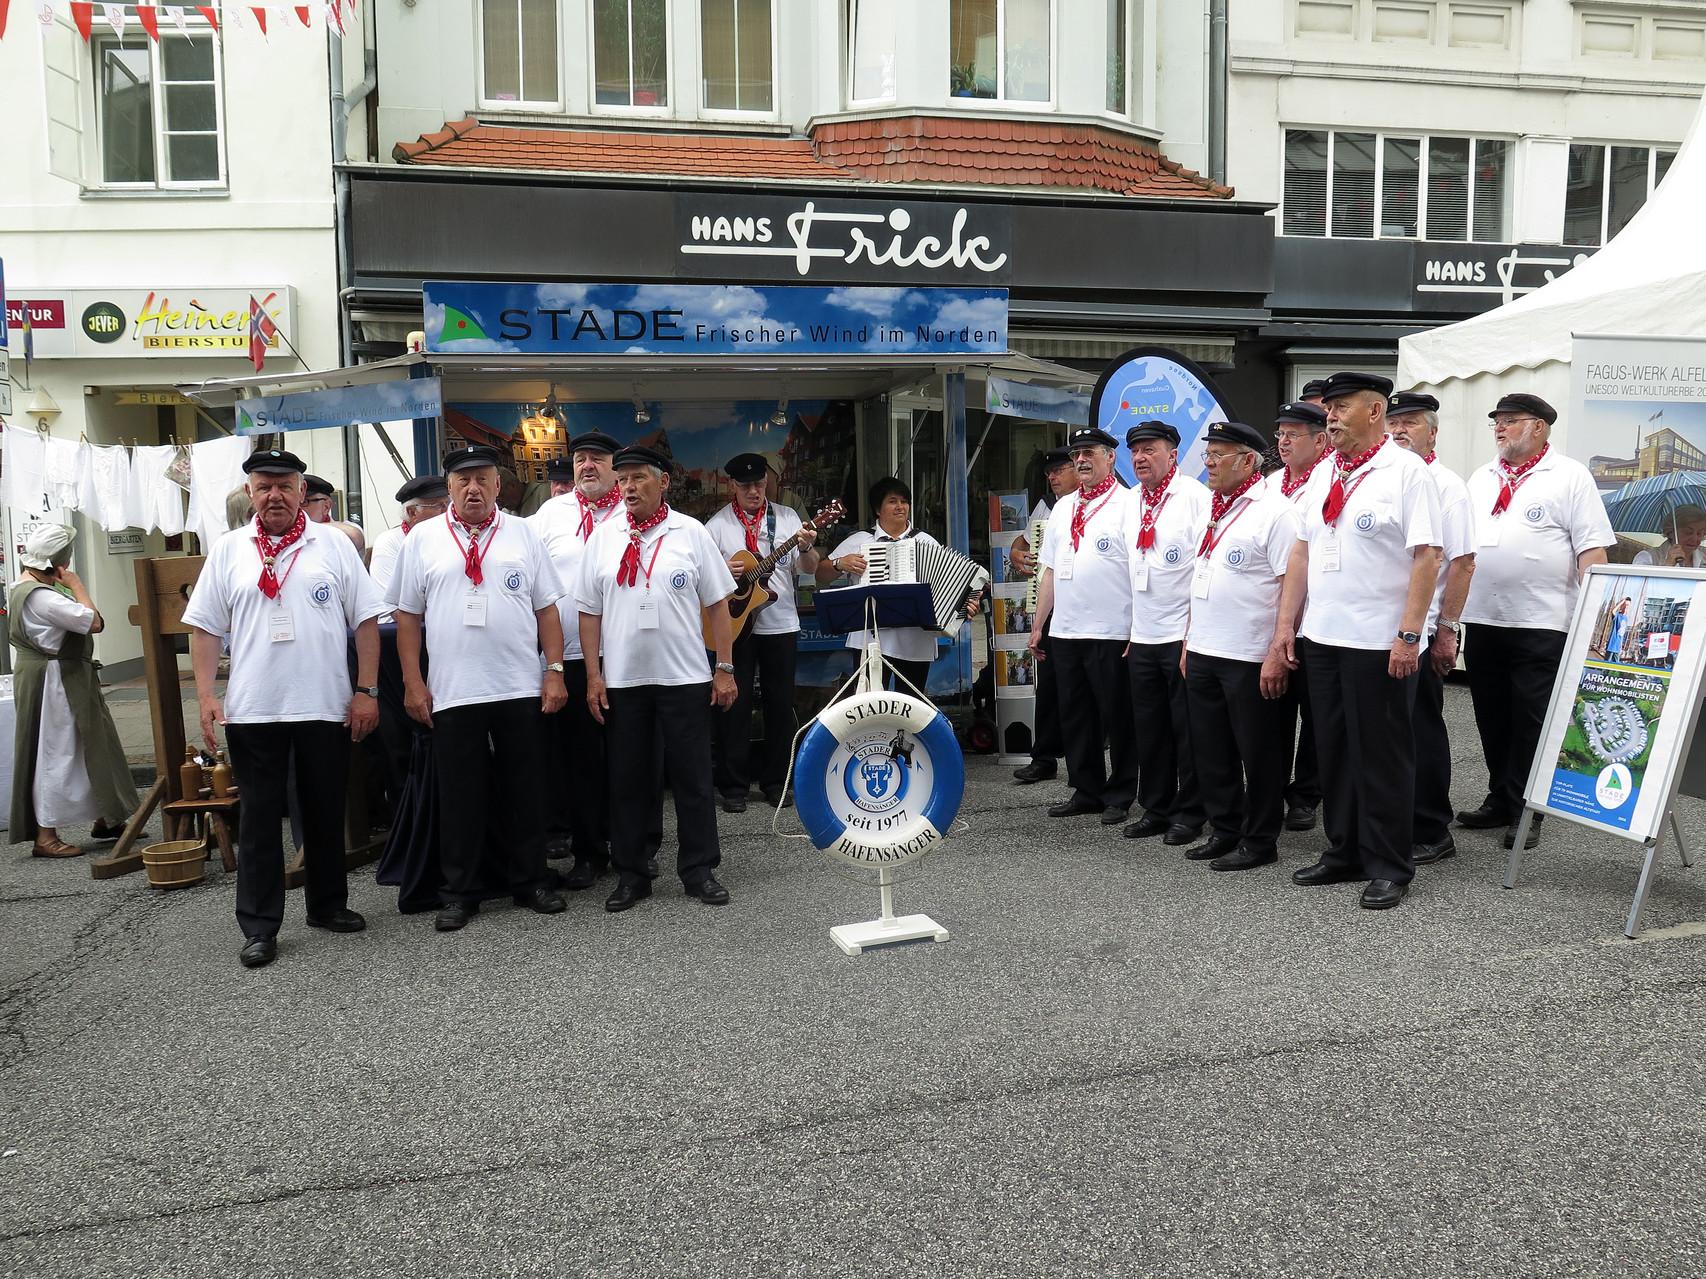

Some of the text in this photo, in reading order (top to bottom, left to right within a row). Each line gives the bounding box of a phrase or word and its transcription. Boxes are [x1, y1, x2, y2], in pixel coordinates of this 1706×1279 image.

[691, 201, 1007, 275] HANS Frick
[1425, 260, 1486, 282] HANS
[88, 315, 119, 332] JEVER
[499, 308, 998, 343] STADE Frischer Wind im Norden
[1587, 364, 1668, 381] FAGUS-WERK
[1585, 384, 1619, 395] UNESCO
[1621, 385, 1695, 397] WELTKULTURERBE
[1002, 392, 1041, 413] STADE
[257, 401, 436, 426] STADE Frischer Wind im Norden
[38, 417, 48, 432] 6
[1584, 672, 1663, 692] ARRANGEMENTS
[1582, 683, 1660, 702] FÜR WOHNMOBILISTEN
[845, 699, 912, 724] STADER
[857, 745, 891, 759] STADER
[1599, 787, 1625, 799] STADE
[845, 810, 908, 831] seit 1977
[838, 828, 936, 862] HAFENSÄNGER
